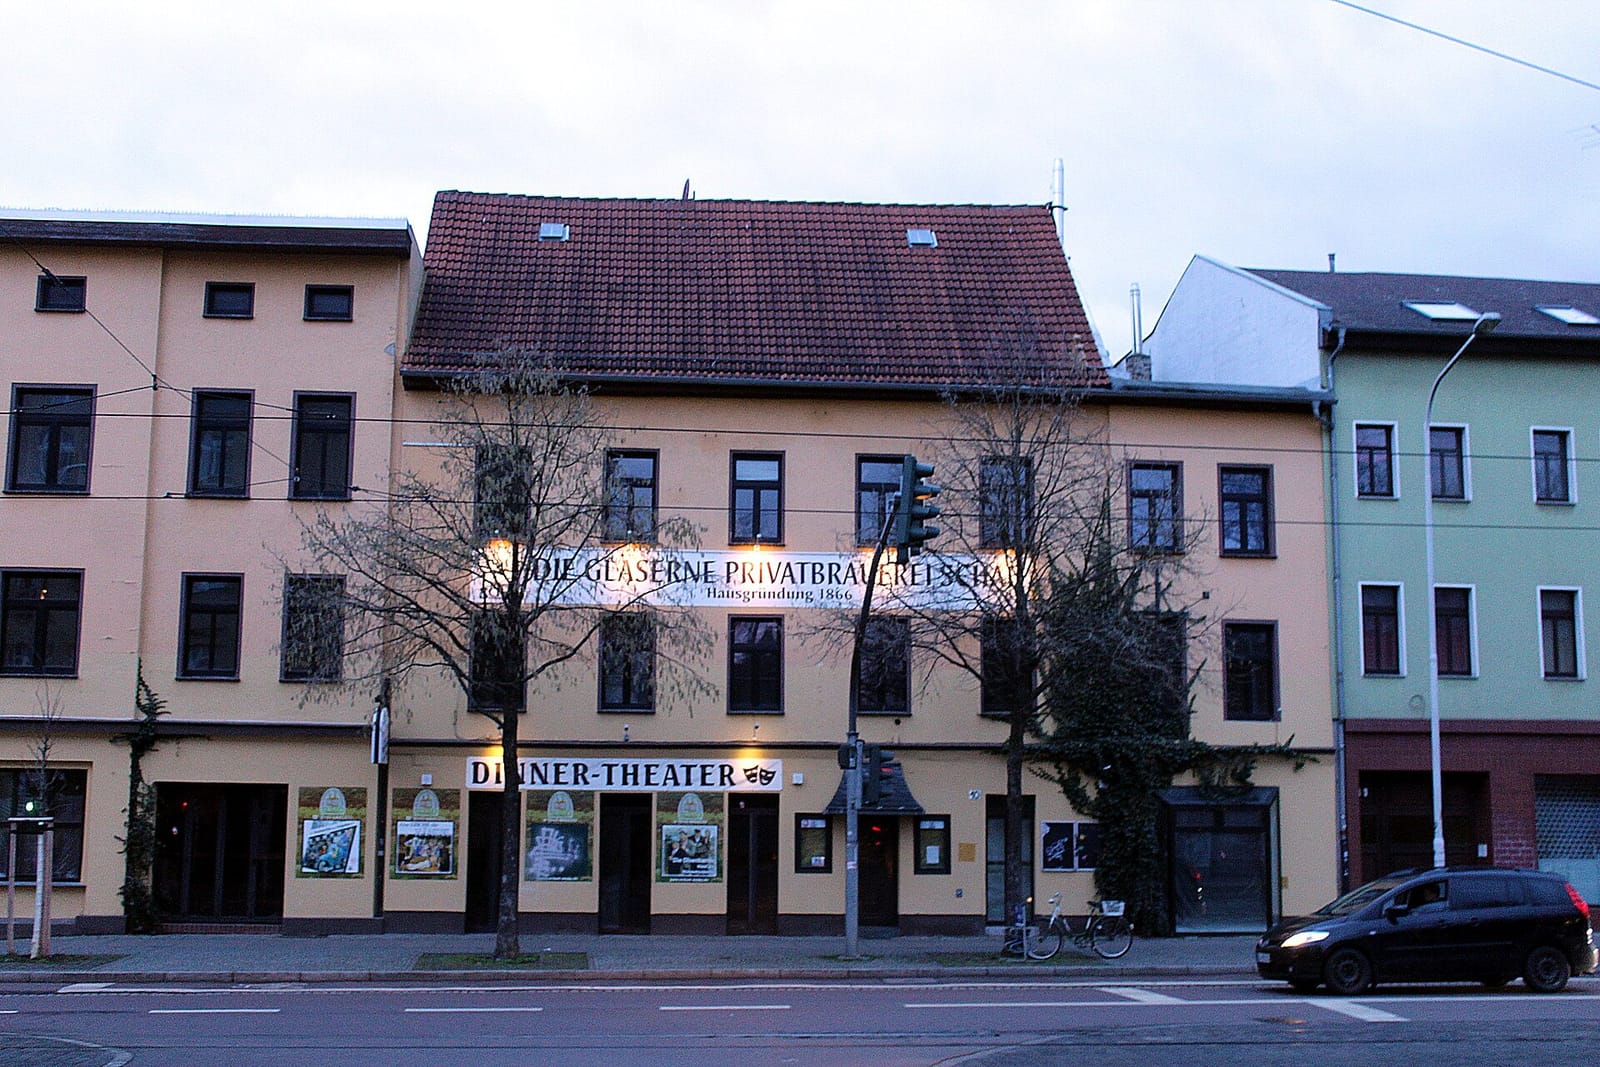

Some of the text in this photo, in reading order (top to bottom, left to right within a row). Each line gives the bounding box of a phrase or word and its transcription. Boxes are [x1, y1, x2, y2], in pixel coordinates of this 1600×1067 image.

[533, 557, 576, 582] DIE
[707, 587, 853, 602] Hausgründung 1866
